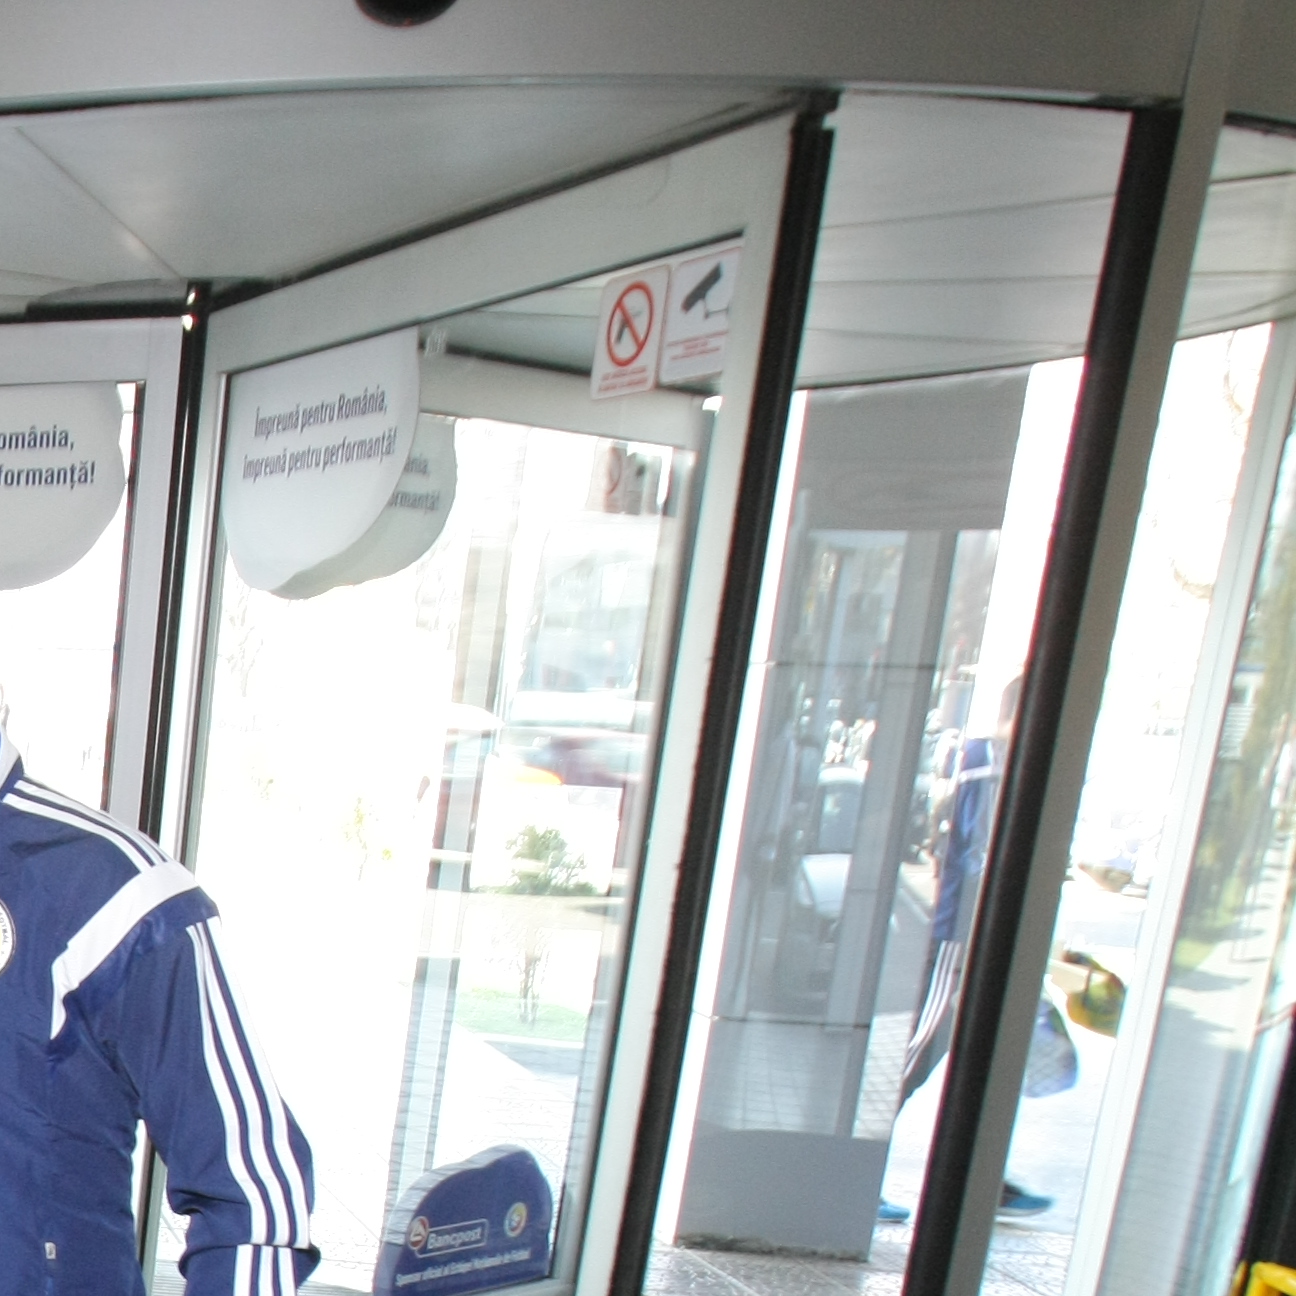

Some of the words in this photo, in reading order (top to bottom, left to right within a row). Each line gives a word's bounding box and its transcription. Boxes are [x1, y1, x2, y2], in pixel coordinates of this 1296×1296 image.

[254, 402, 300, 440] Împreună
[300, 401, 337, 433] pentru
[337, 384, 388, 419] România,
[242, 448, 287, 483] împreună
[287, 445, 322, 478] pentru
[426, 1227, 483, 1250] Bancpost
